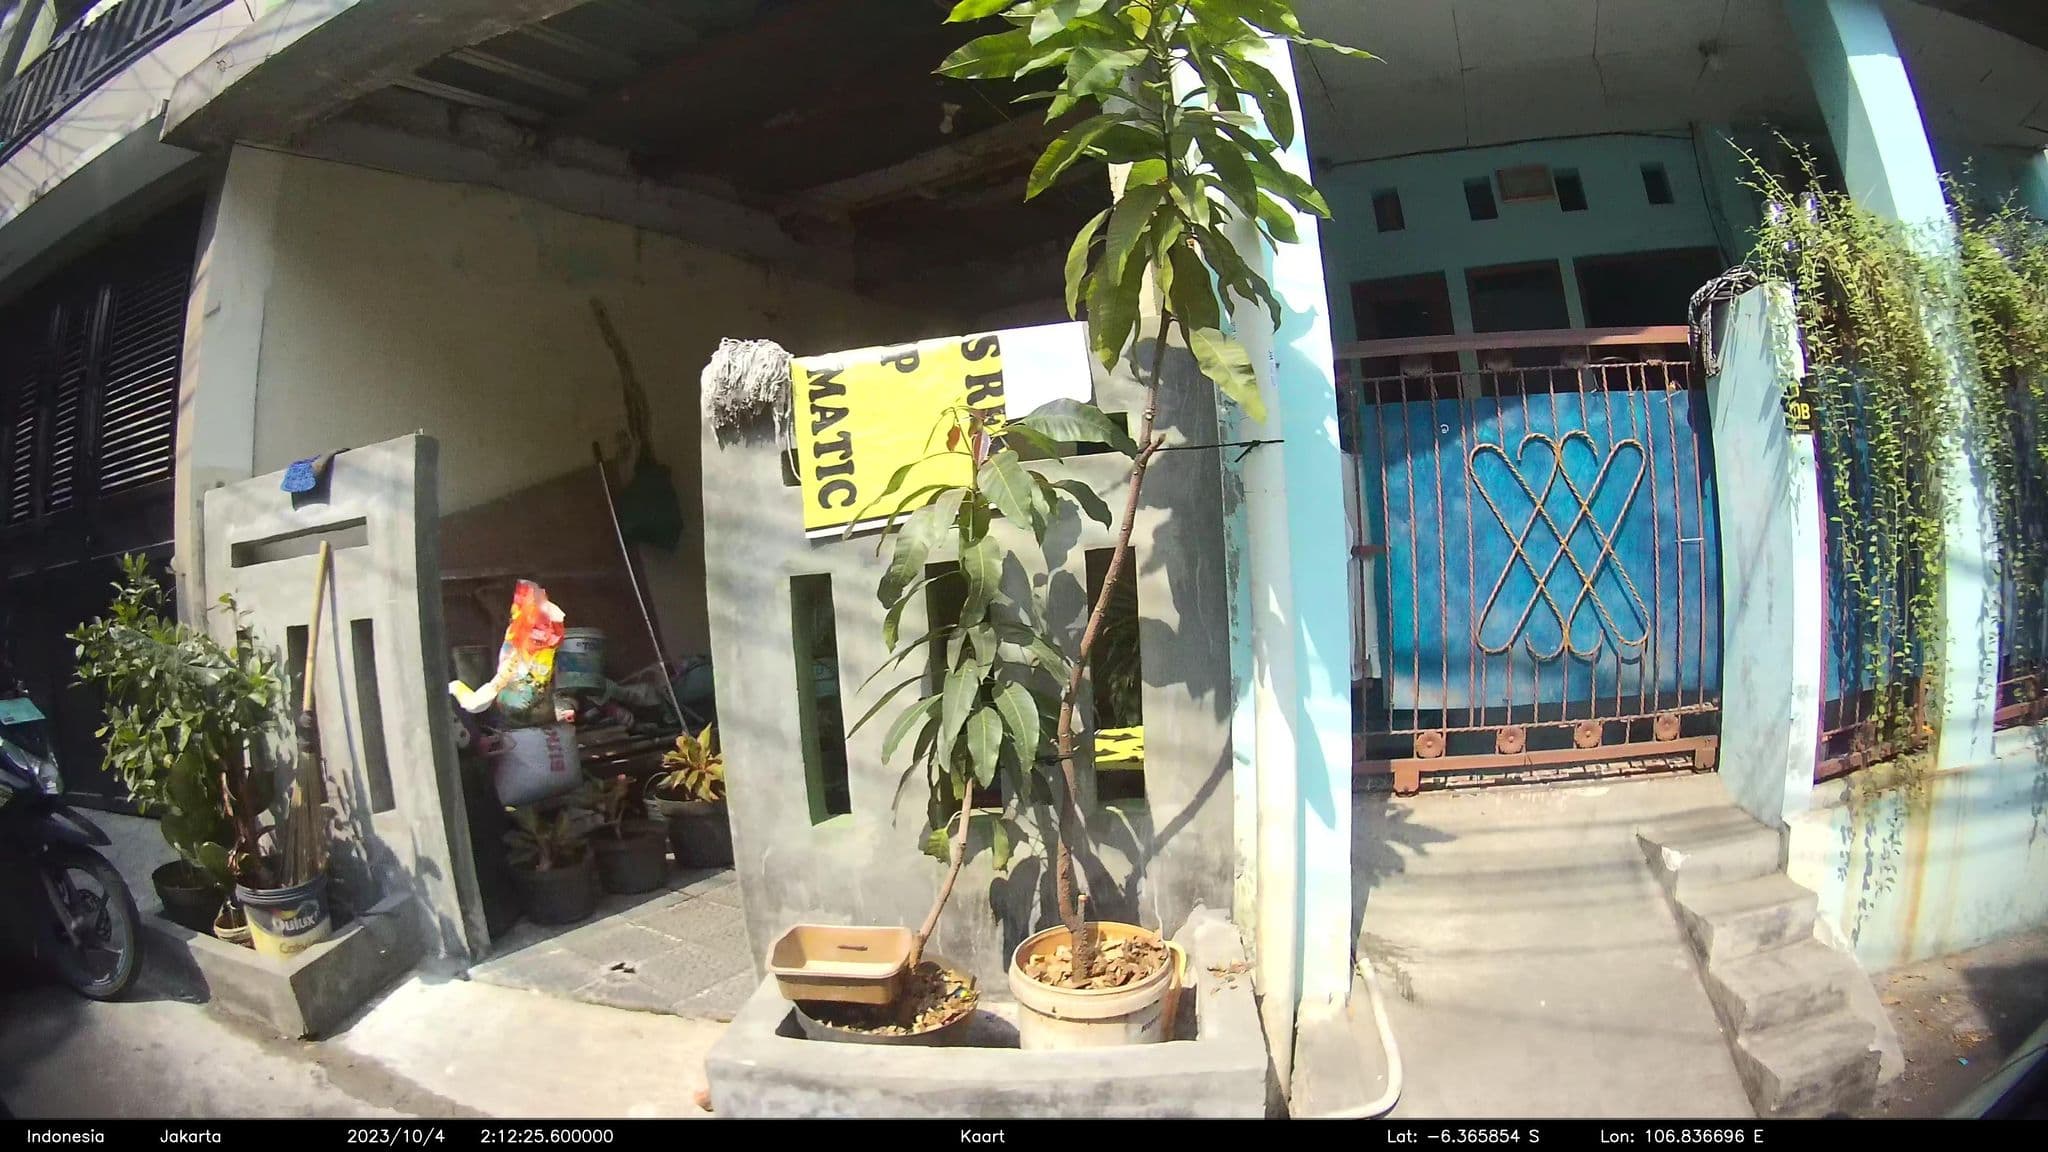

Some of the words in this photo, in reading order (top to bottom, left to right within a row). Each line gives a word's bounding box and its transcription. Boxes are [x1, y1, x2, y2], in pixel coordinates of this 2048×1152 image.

[880, 348, 920, 374] P
[806, 367, 858, 511] MATIC
[271, 914, 316, 932] Dulux
